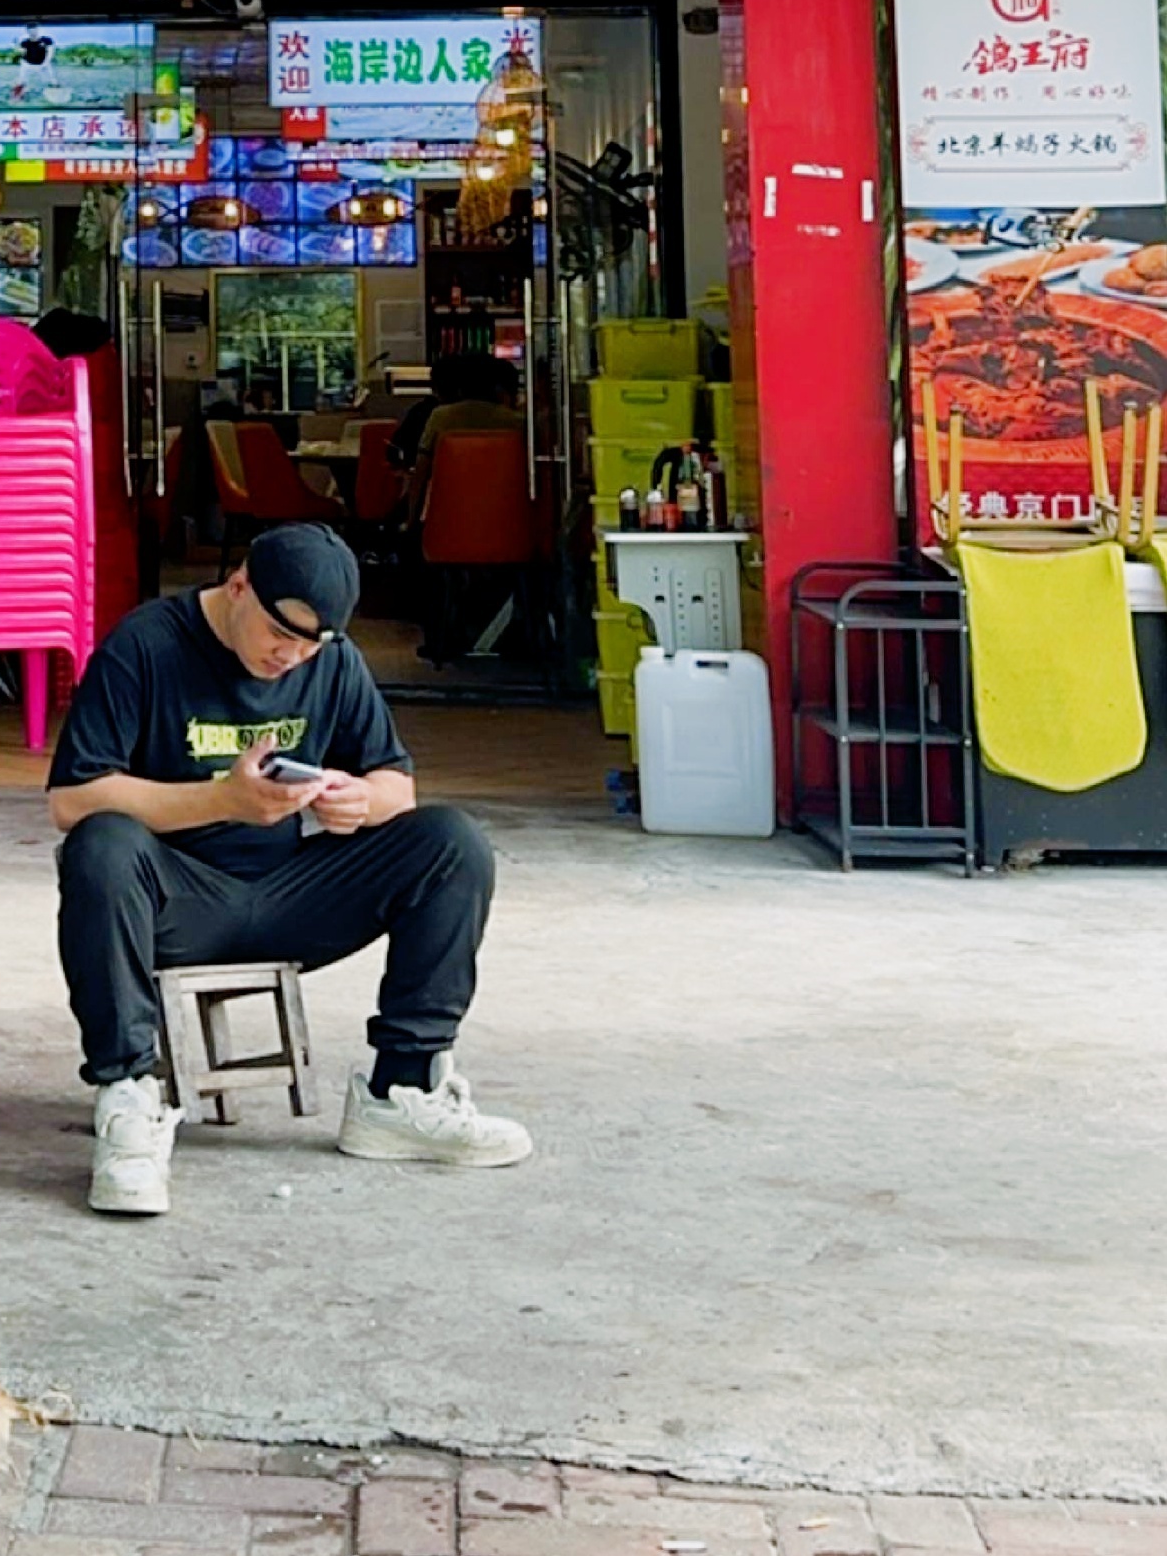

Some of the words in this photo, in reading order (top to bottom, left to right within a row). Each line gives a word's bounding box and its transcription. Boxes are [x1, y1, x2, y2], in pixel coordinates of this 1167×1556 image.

[323, 36, 494, 85] 海岸边人家
[937, 132, 1118, 157] 北京羊蝎子火锅
